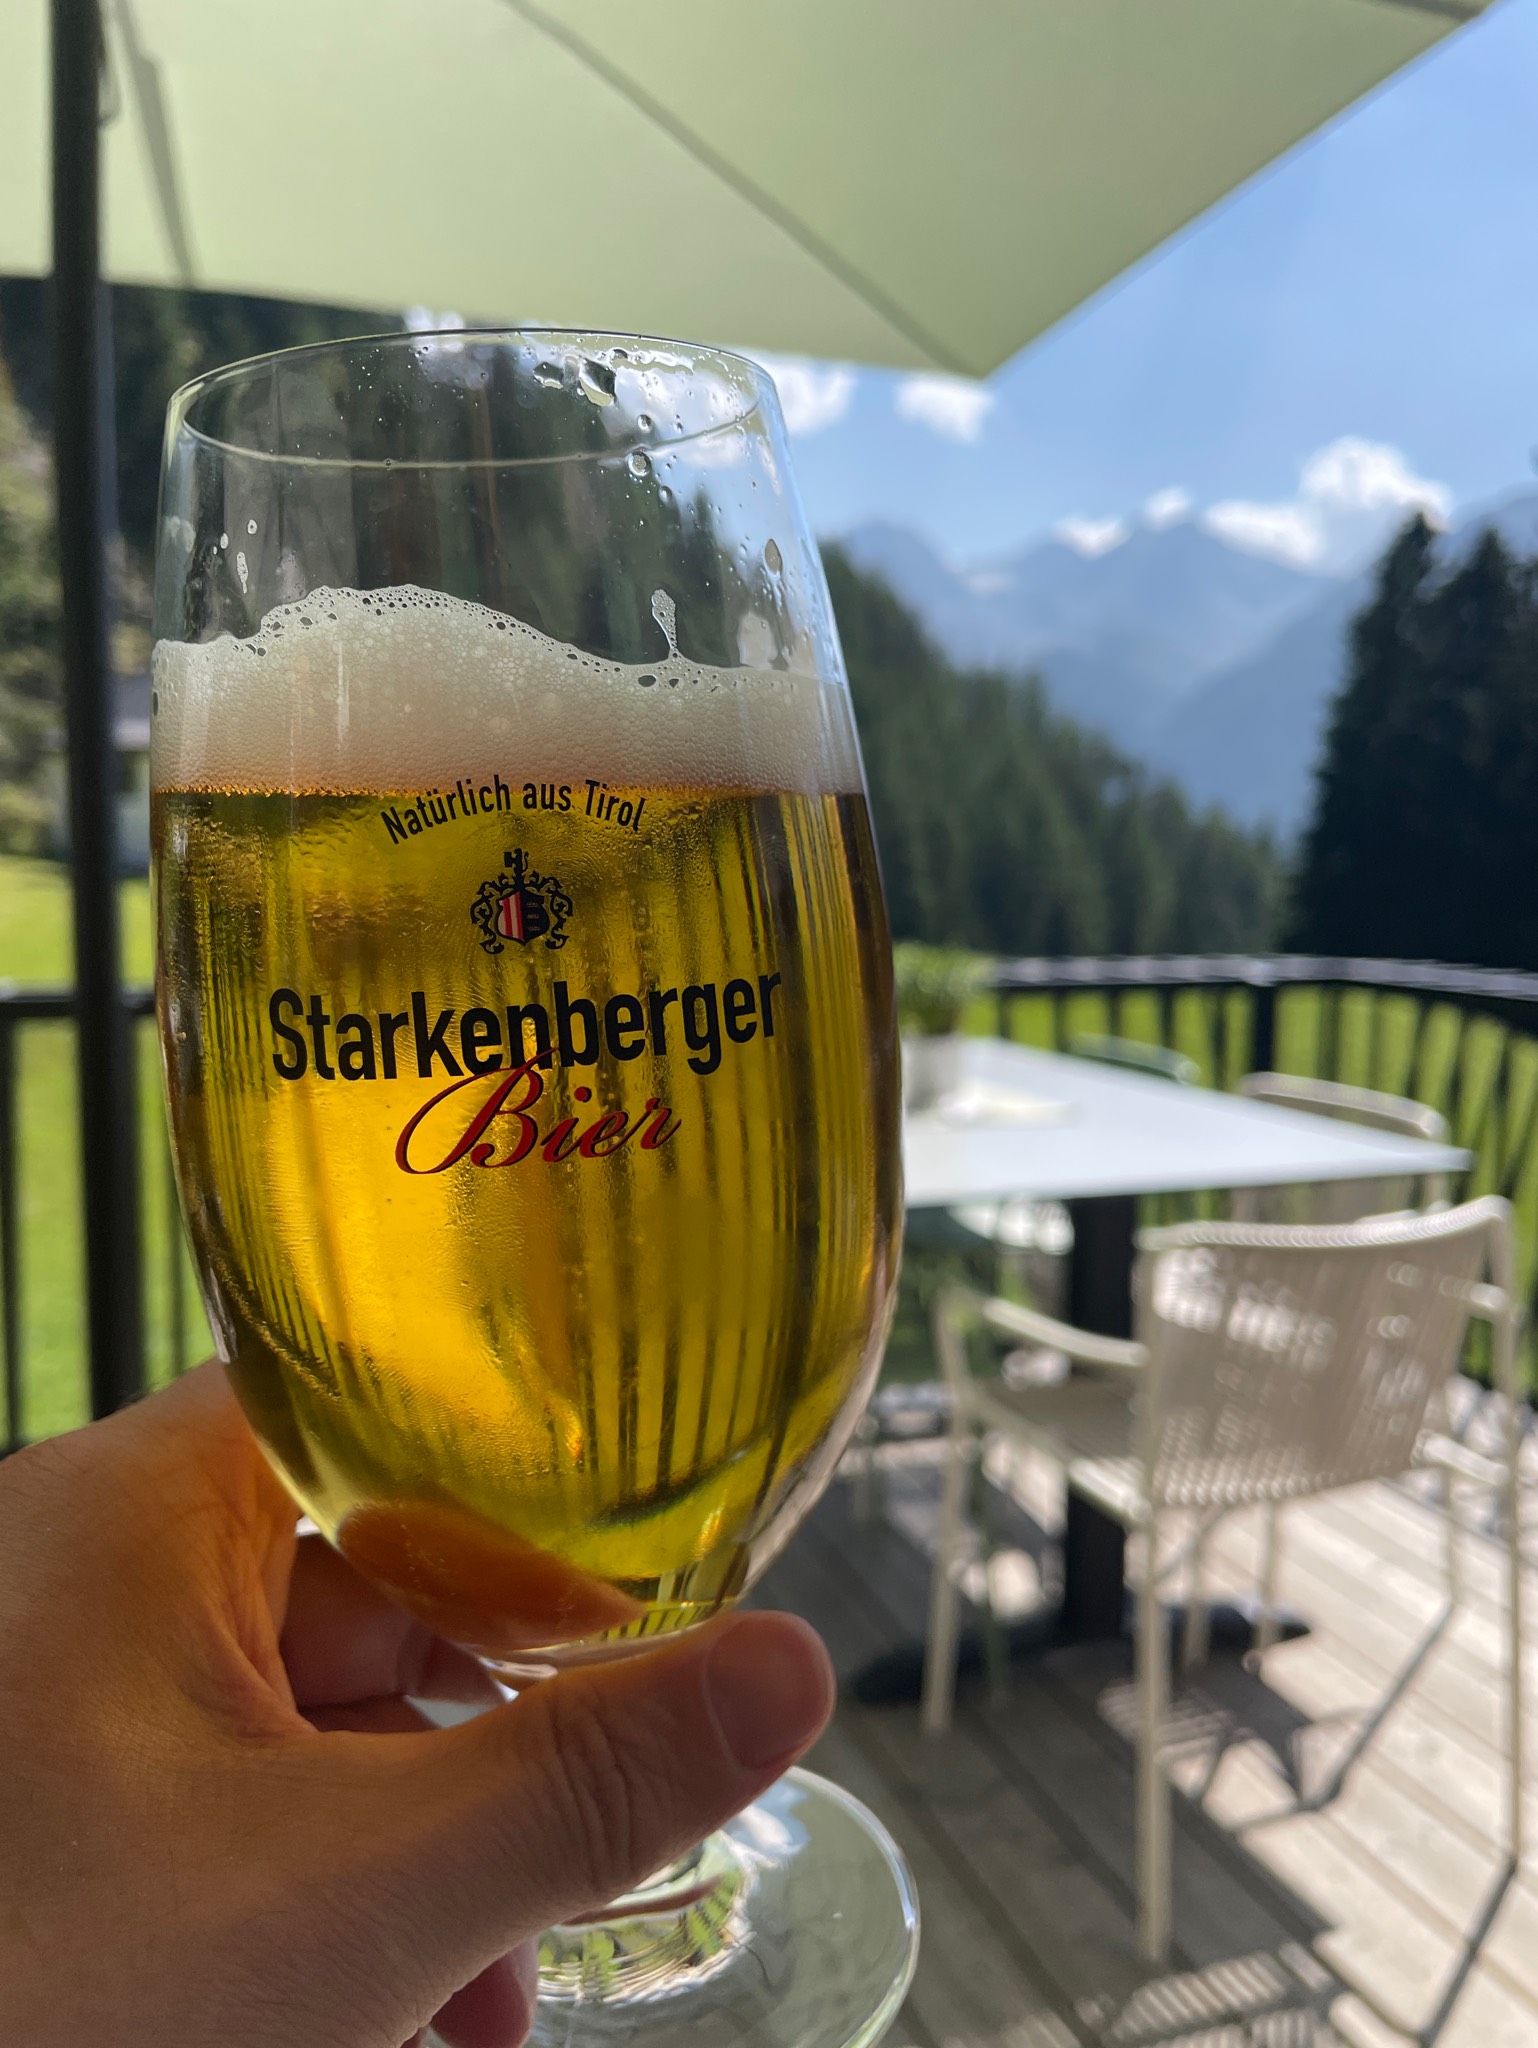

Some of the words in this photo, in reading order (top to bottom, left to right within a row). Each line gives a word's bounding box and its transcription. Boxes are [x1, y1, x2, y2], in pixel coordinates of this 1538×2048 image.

[381, 774, 511, 845] Natürlich
[523, 782, 572, 812] aus
[585, 779, 646, 832] Tirol
[269, 972, 782, 1081] Starkenberger
[395, 1047, 682, 1175] Bier
